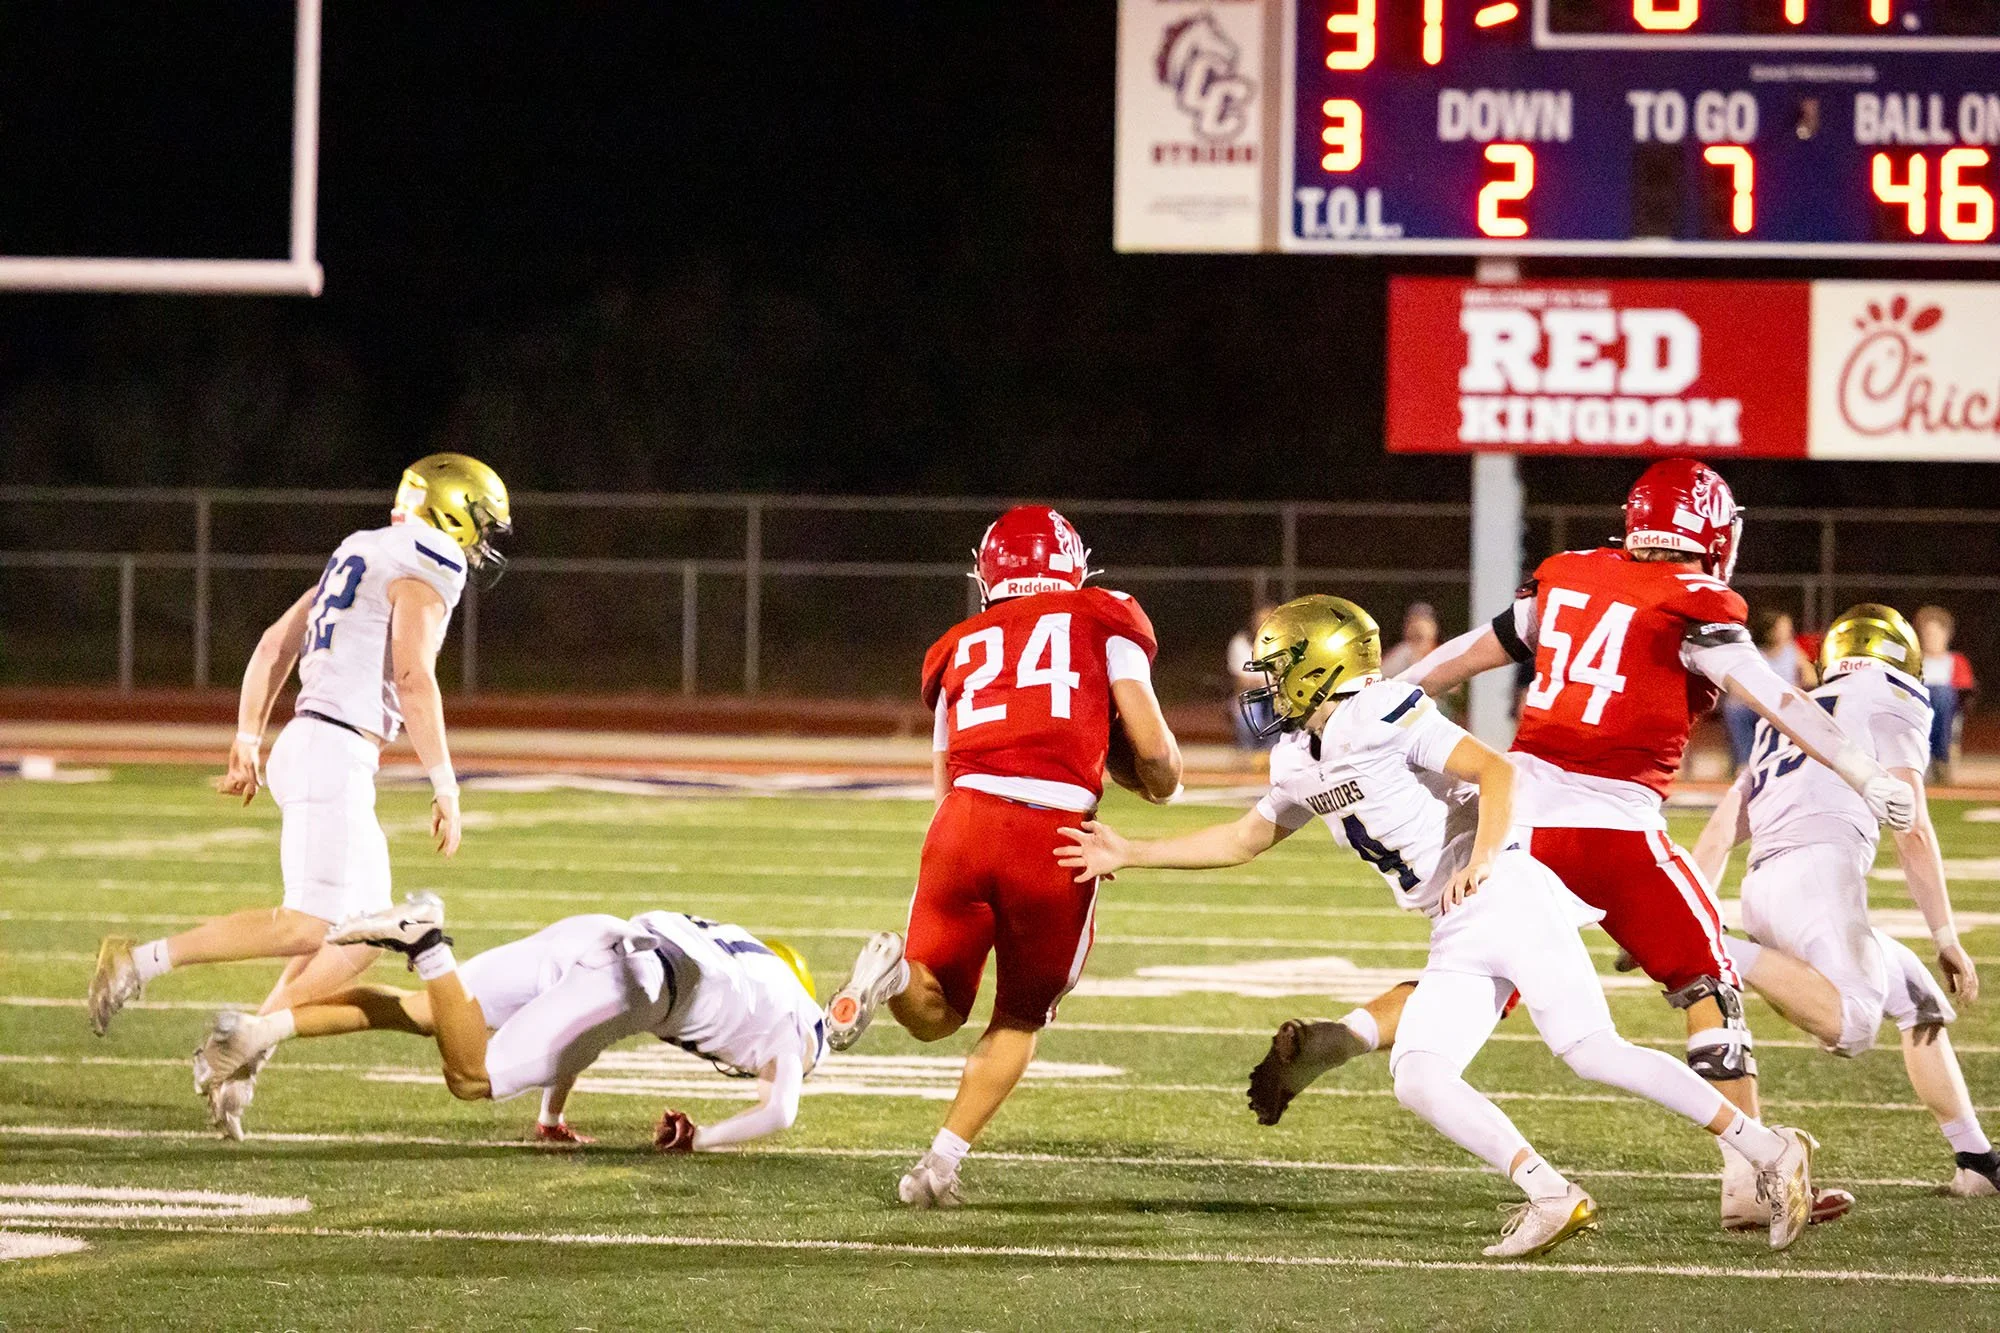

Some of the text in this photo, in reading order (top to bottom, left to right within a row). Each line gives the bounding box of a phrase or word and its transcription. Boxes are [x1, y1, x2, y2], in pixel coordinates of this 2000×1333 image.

[1321, 99, 1363, 172] 3
[1437, 88, 1573, 142] DOWN
[1626, 90, 1759, 143] TO GO
[1854, 92, 1954, 145] BALL
[1478, 144, 1535, 237] 2
[1703, 146, 1754, 233] 7
[1872, 148, 1994, 241] 46
[1458, 308, 1701, 396] RED
[1837, 329, 2000, 437] Chic
[1457, 395, 1742, 446] KINGDOM
[954, 612, 1080, 731] 24
[1526, 587, 1637, 725] 54
[1305, 780, 1365, 815] WARRIORS
[1342, 813, 1421, 893] 4
